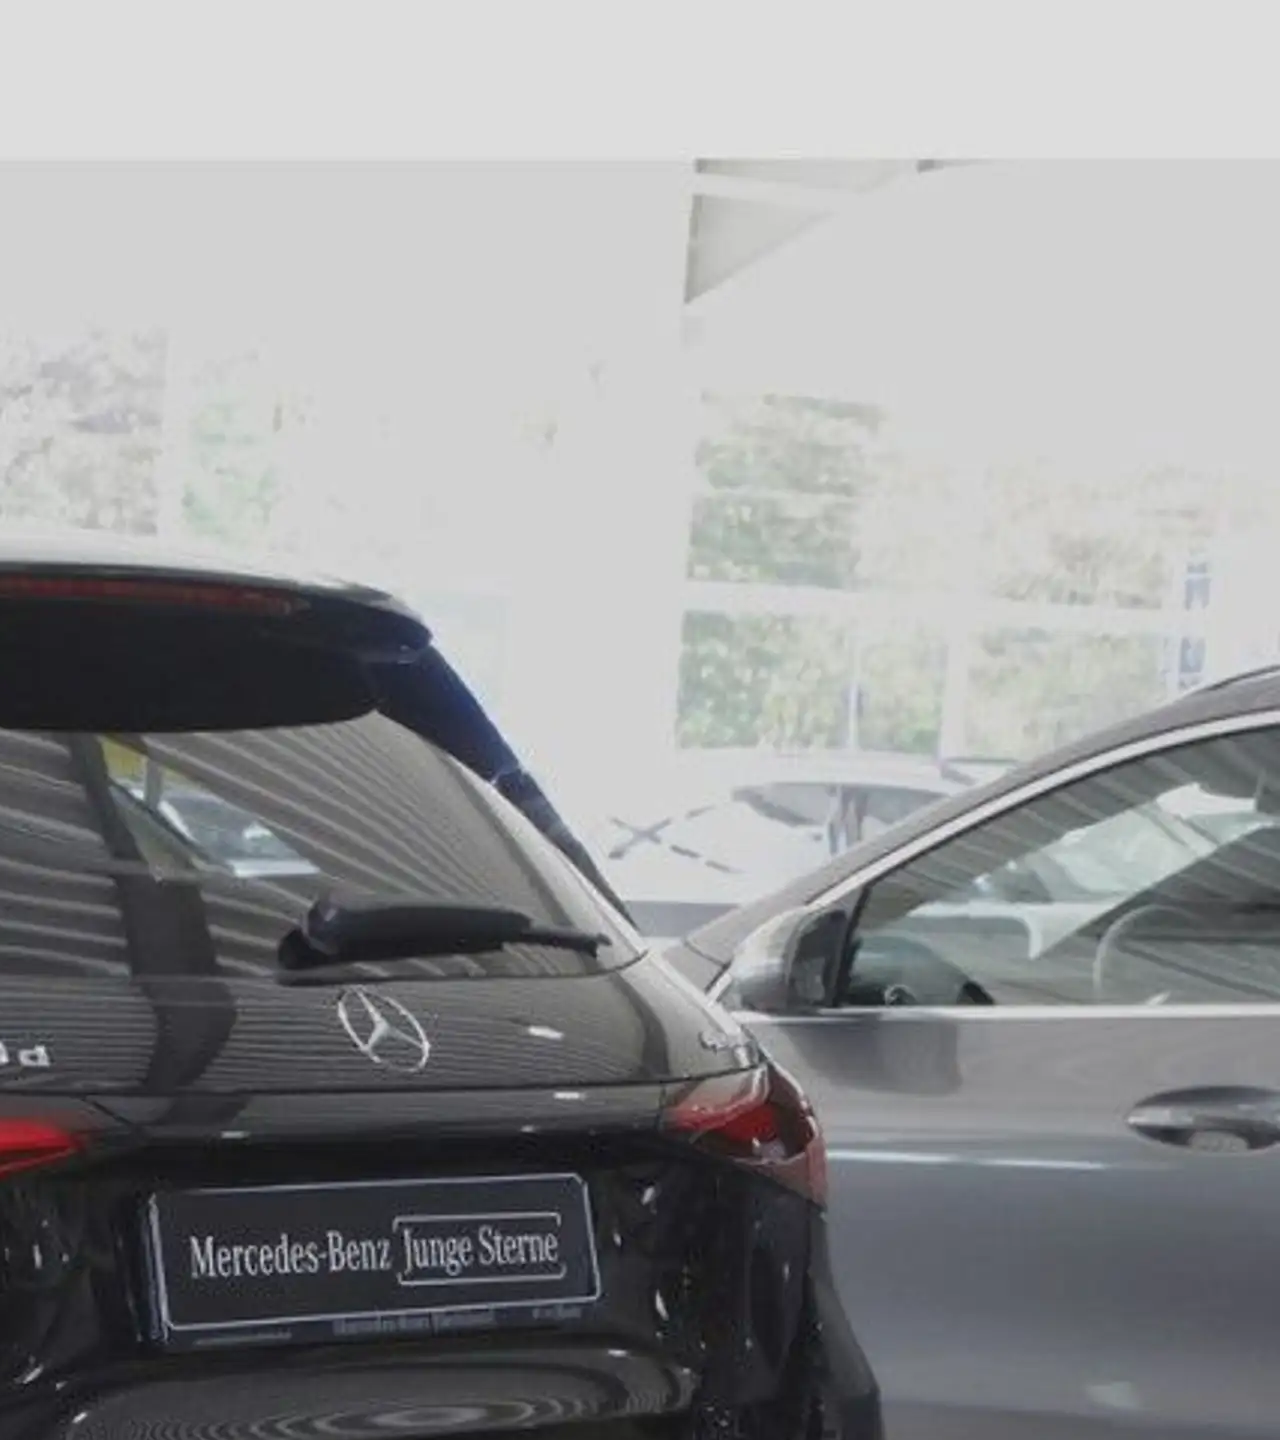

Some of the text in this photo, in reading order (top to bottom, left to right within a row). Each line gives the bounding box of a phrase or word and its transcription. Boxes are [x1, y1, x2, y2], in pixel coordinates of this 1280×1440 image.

[188, 1224, 560, 1279] Mercedes-Benz Junge Sterne
